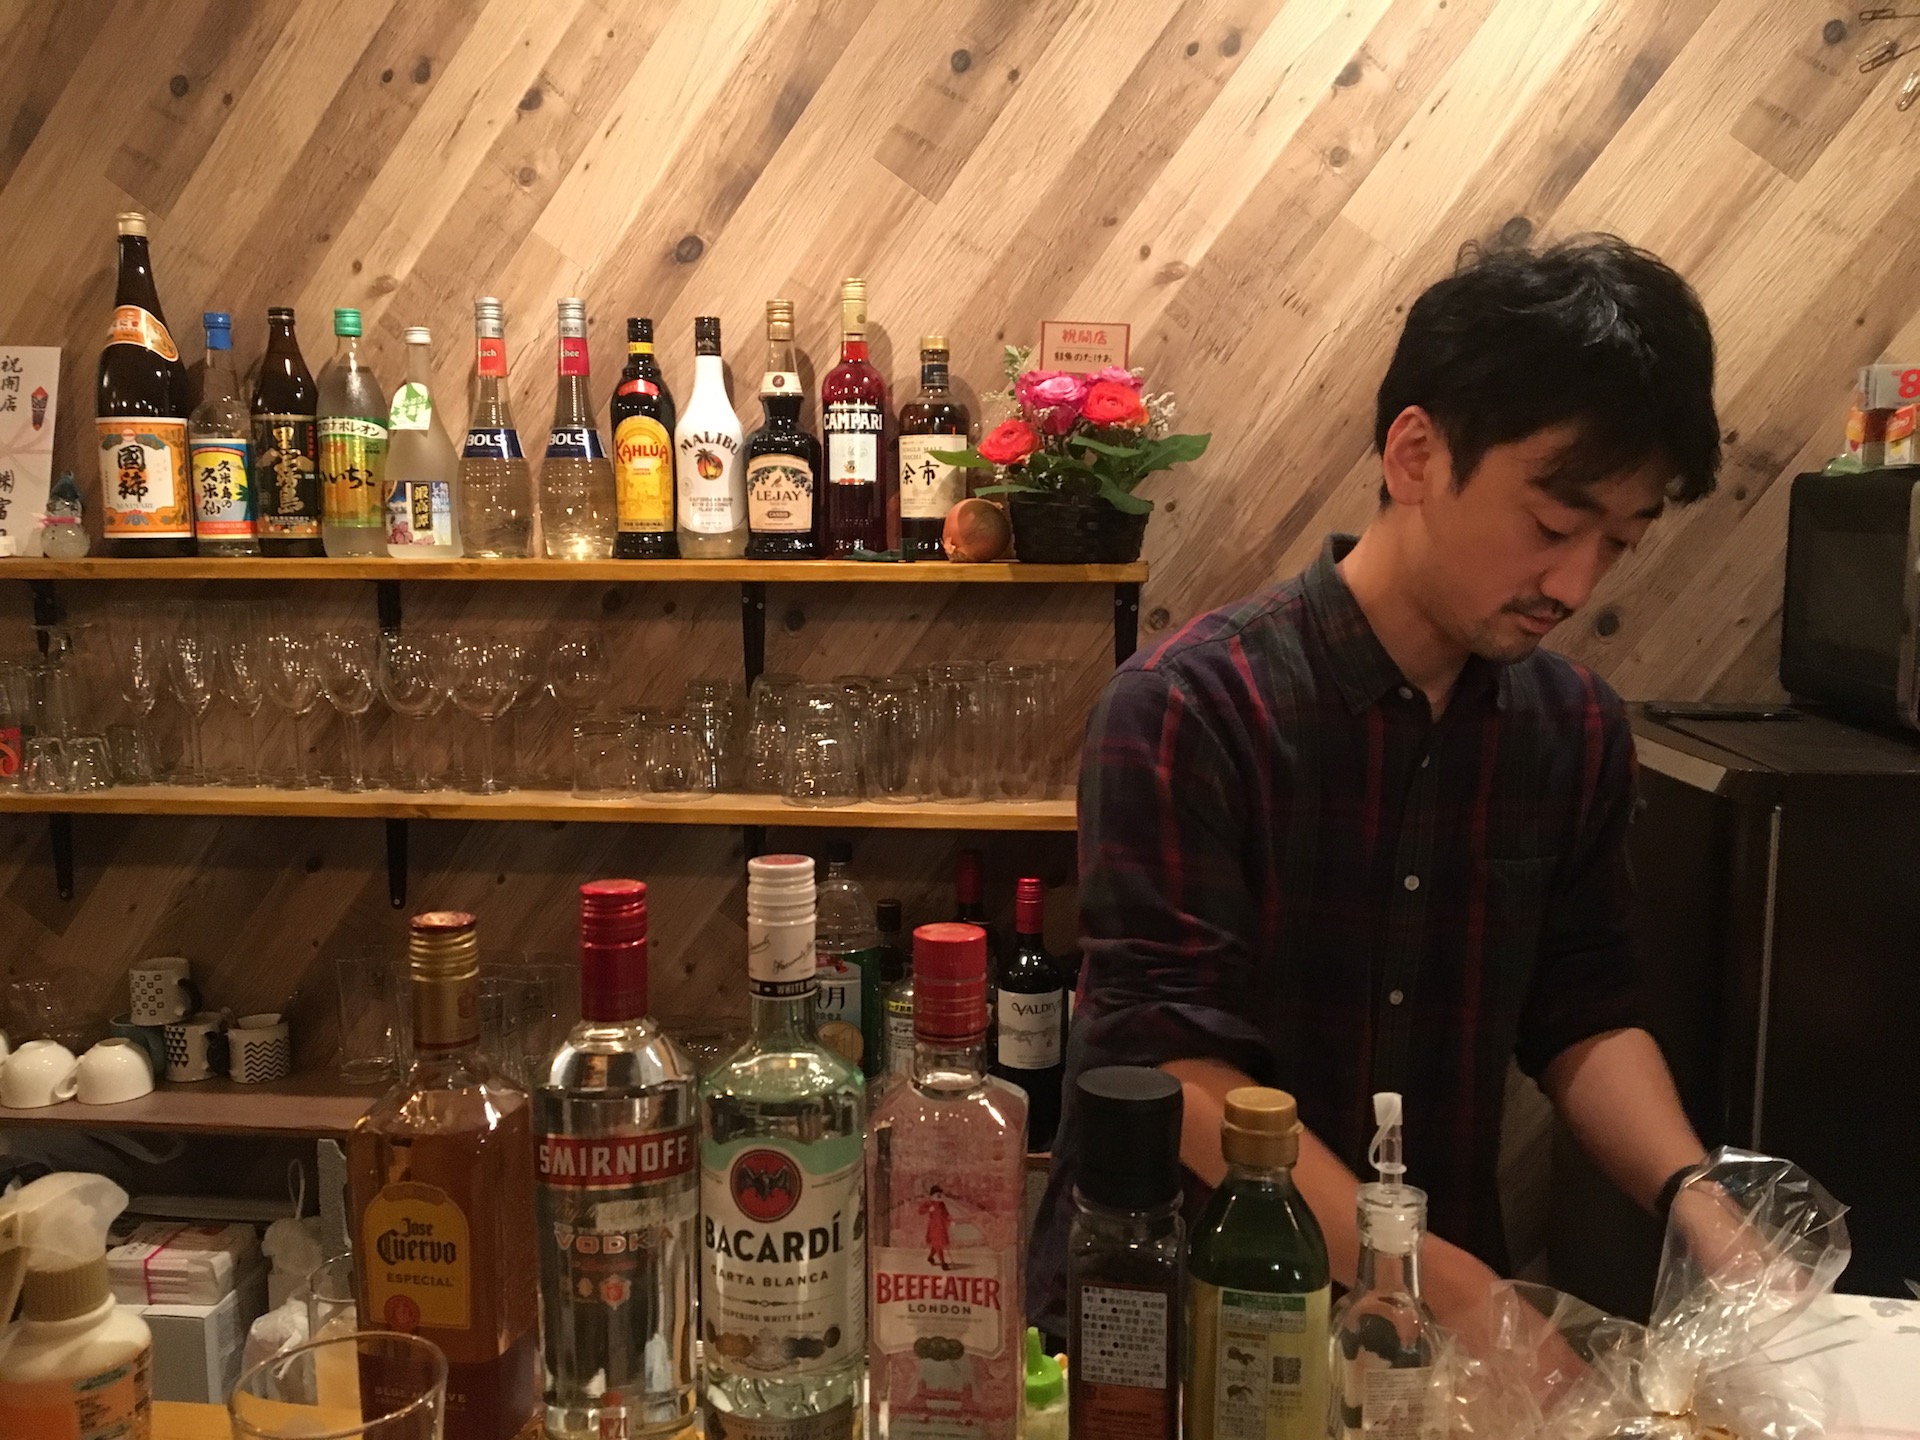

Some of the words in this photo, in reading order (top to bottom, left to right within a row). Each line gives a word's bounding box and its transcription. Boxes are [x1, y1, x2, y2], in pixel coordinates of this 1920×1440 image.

[824, 412, 883, 431] CAMPARI
[467, 433, 505, 447] BOLS
[550, 433, 586, 447] BOLS
[616, 439, 669, 465] KAHLÚA
[680, 431, 740, 456] MALIBU
[218, 460, 233, 509] 久米島の
[902, 460, 940, 486] 余市
[201, 467, 221, 516] 久米仙
[756, 490, 801, 501] LEJAY
[777, 981, 805, 994] WHITE
[540, 1136, 687, 1177] SMIRNOFF
[401, 1217, 433, 1238] Jose
[706, 1210, 842, 1263] BACARDÍ
[376, 1229, 457, 1266] Cuervo
[387, 1273, 454, 1287] ESPECIAL
[711, 1264, 755, 1286] CARTA
[763, 1270, 829, 1287] BLANCA
[876, 1272, 1002, 1311] BEEFEATER
[908, 1303, 972, 1315] LONDON
